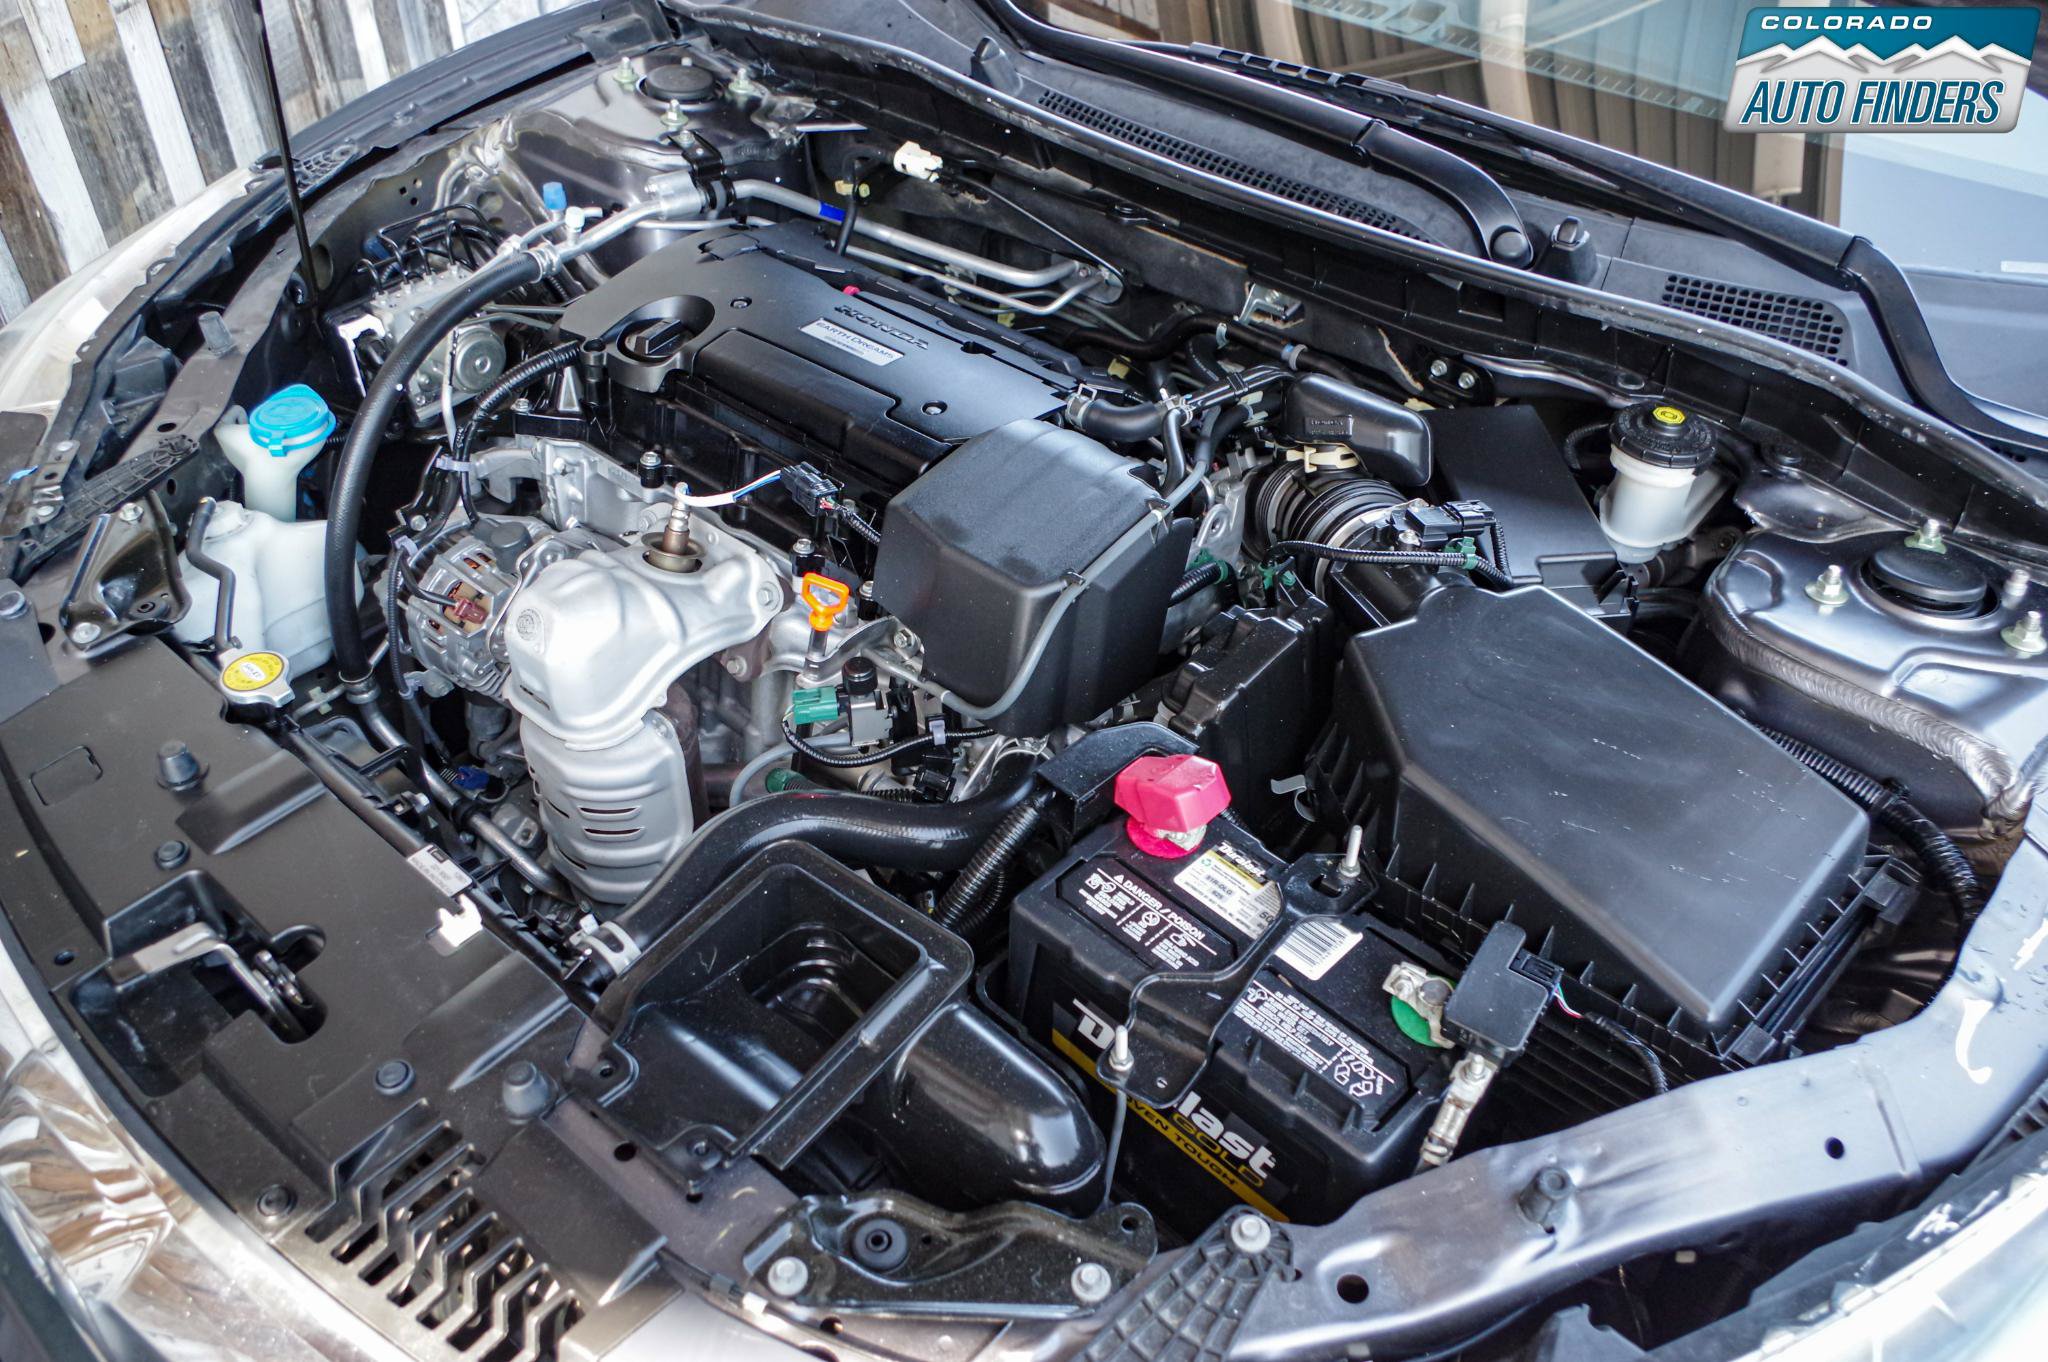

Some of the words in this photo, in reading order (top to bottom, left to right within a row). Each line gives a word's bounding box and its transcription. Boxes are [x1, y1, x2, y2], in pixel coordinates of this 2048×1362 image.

[816, 322, 856, 342] EARTH
[851, 336, 894, 360] DREAMS
[834, 305, 929, 350] HONDA
[1216, 842, 1267, 878] Duralast
[1122, 880, 1163, 909] DANGER
[1167, 911, 1205, 940] POISON
[1172, 1112, 1265, 1187] GOLD
[1174, 1131, 1237, 1185] TOUGH
